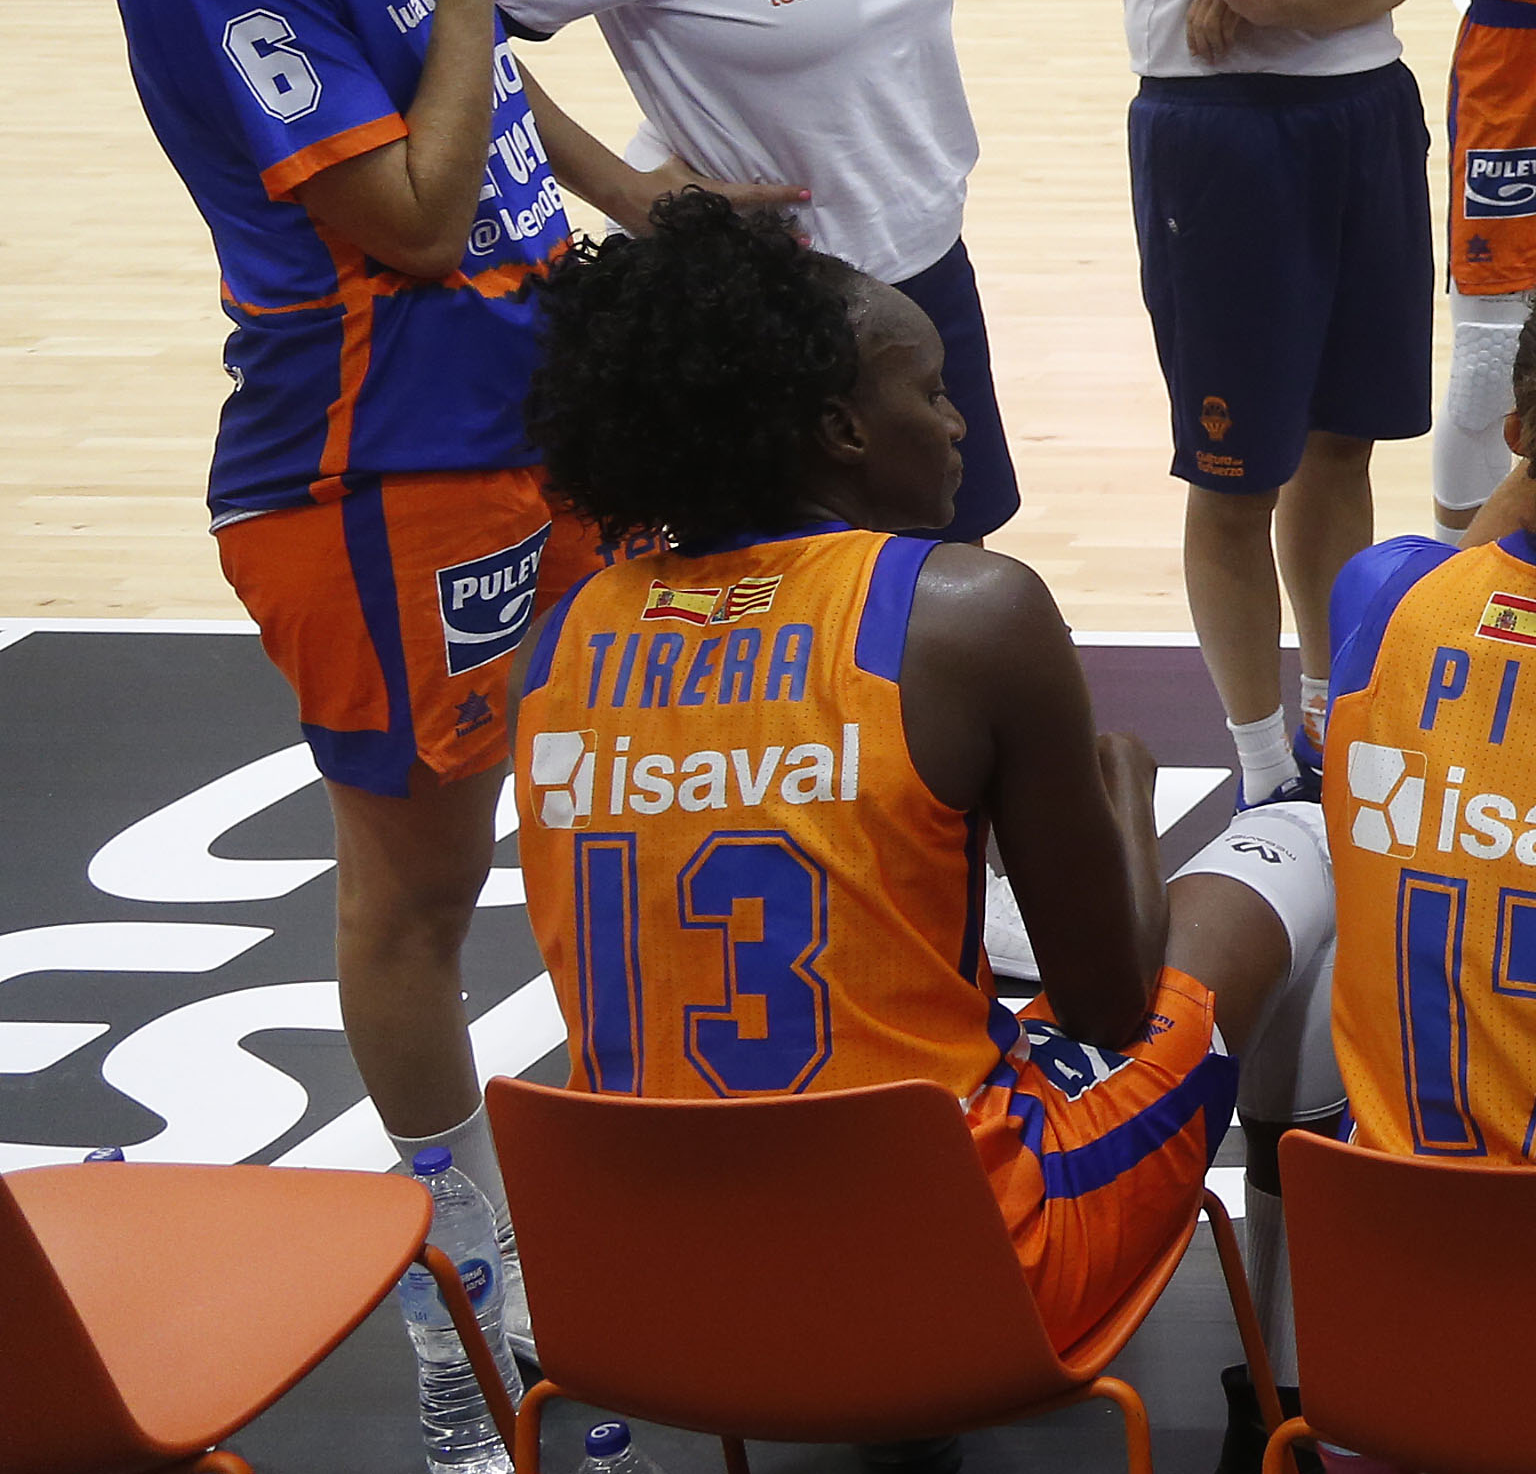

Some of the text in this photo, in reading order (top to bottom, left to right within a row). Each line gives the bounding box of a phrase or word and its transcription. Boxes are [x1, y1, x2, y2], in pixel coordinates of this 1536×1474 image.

[221, 8, 324, 125] 6
[451, 540, 546, 611] PULEV
[587, 622, 814, 709] TIRERA
[609, 722, 861, 816] isaval
[574, 829, 833, 1100] 13
